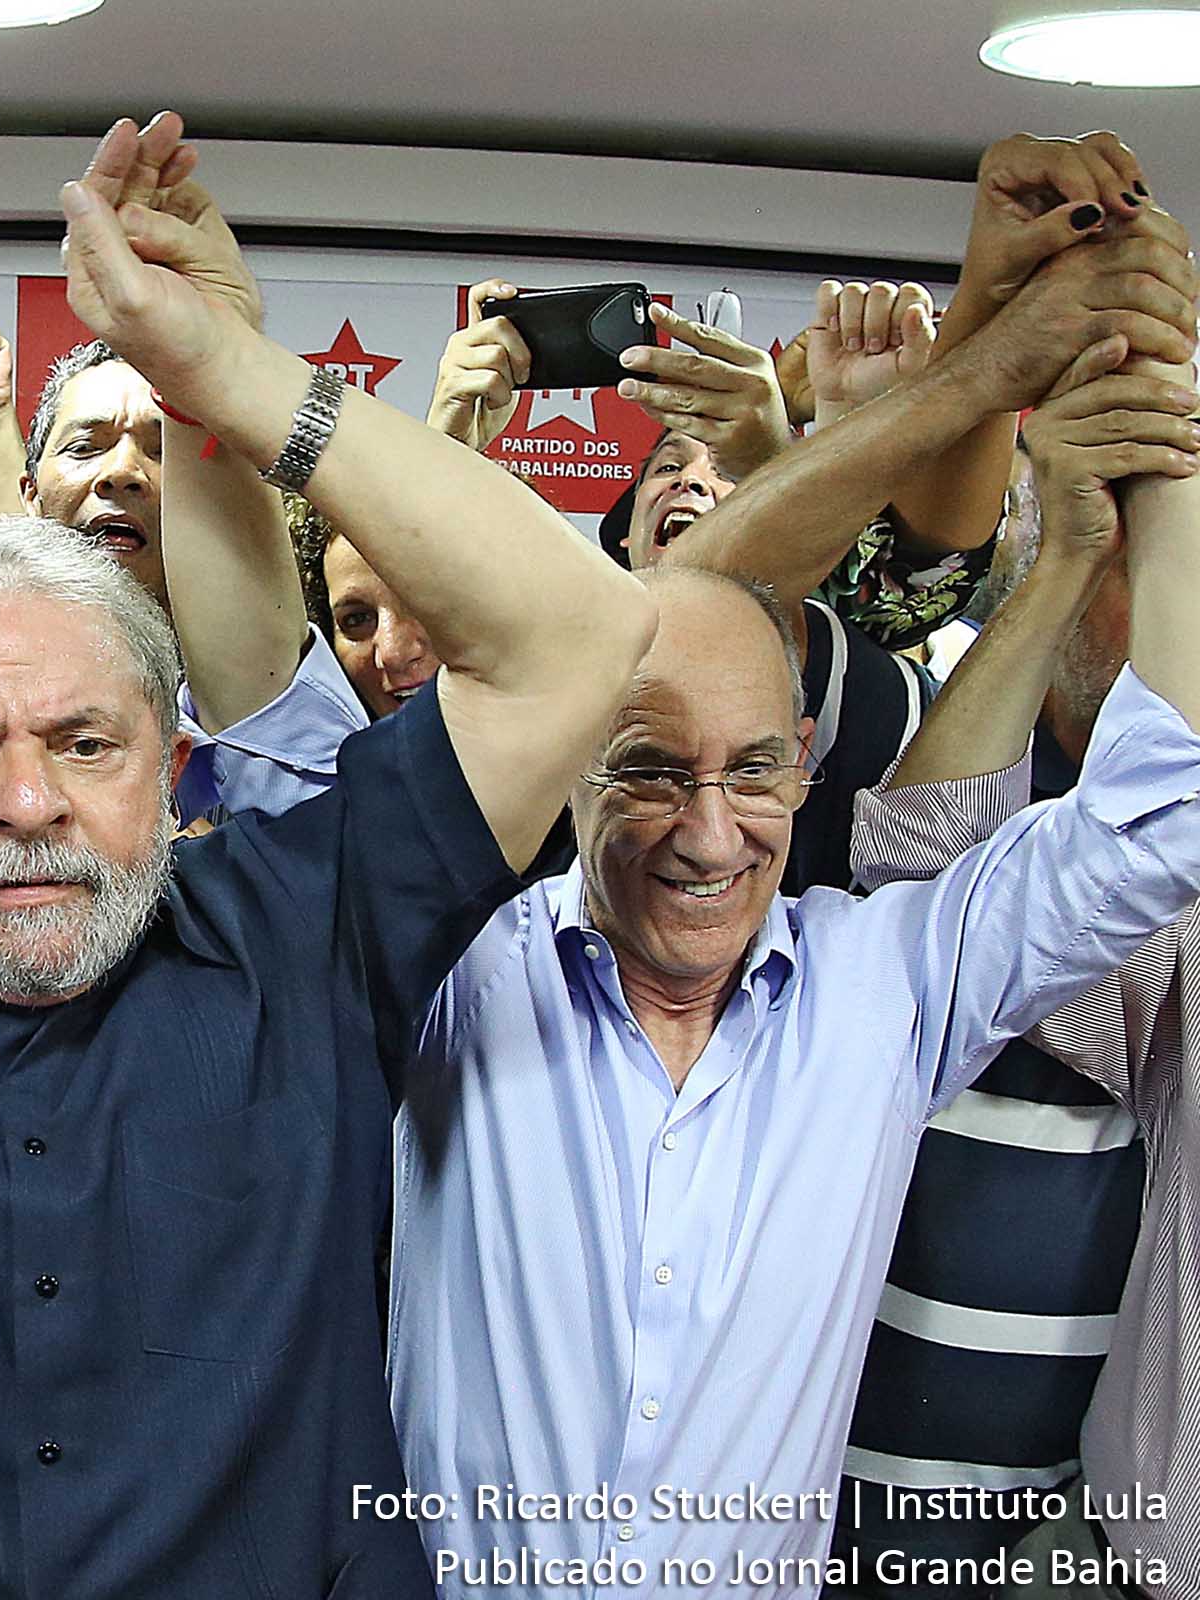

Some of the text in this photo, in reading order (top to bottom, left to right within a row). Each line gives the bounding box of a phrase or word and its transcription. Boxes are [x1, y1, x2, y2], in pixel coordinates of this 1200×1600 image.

[501, 437, 620, 456] PARTIDO DOS
[498, 460, 633, 480] ABALHADORES
